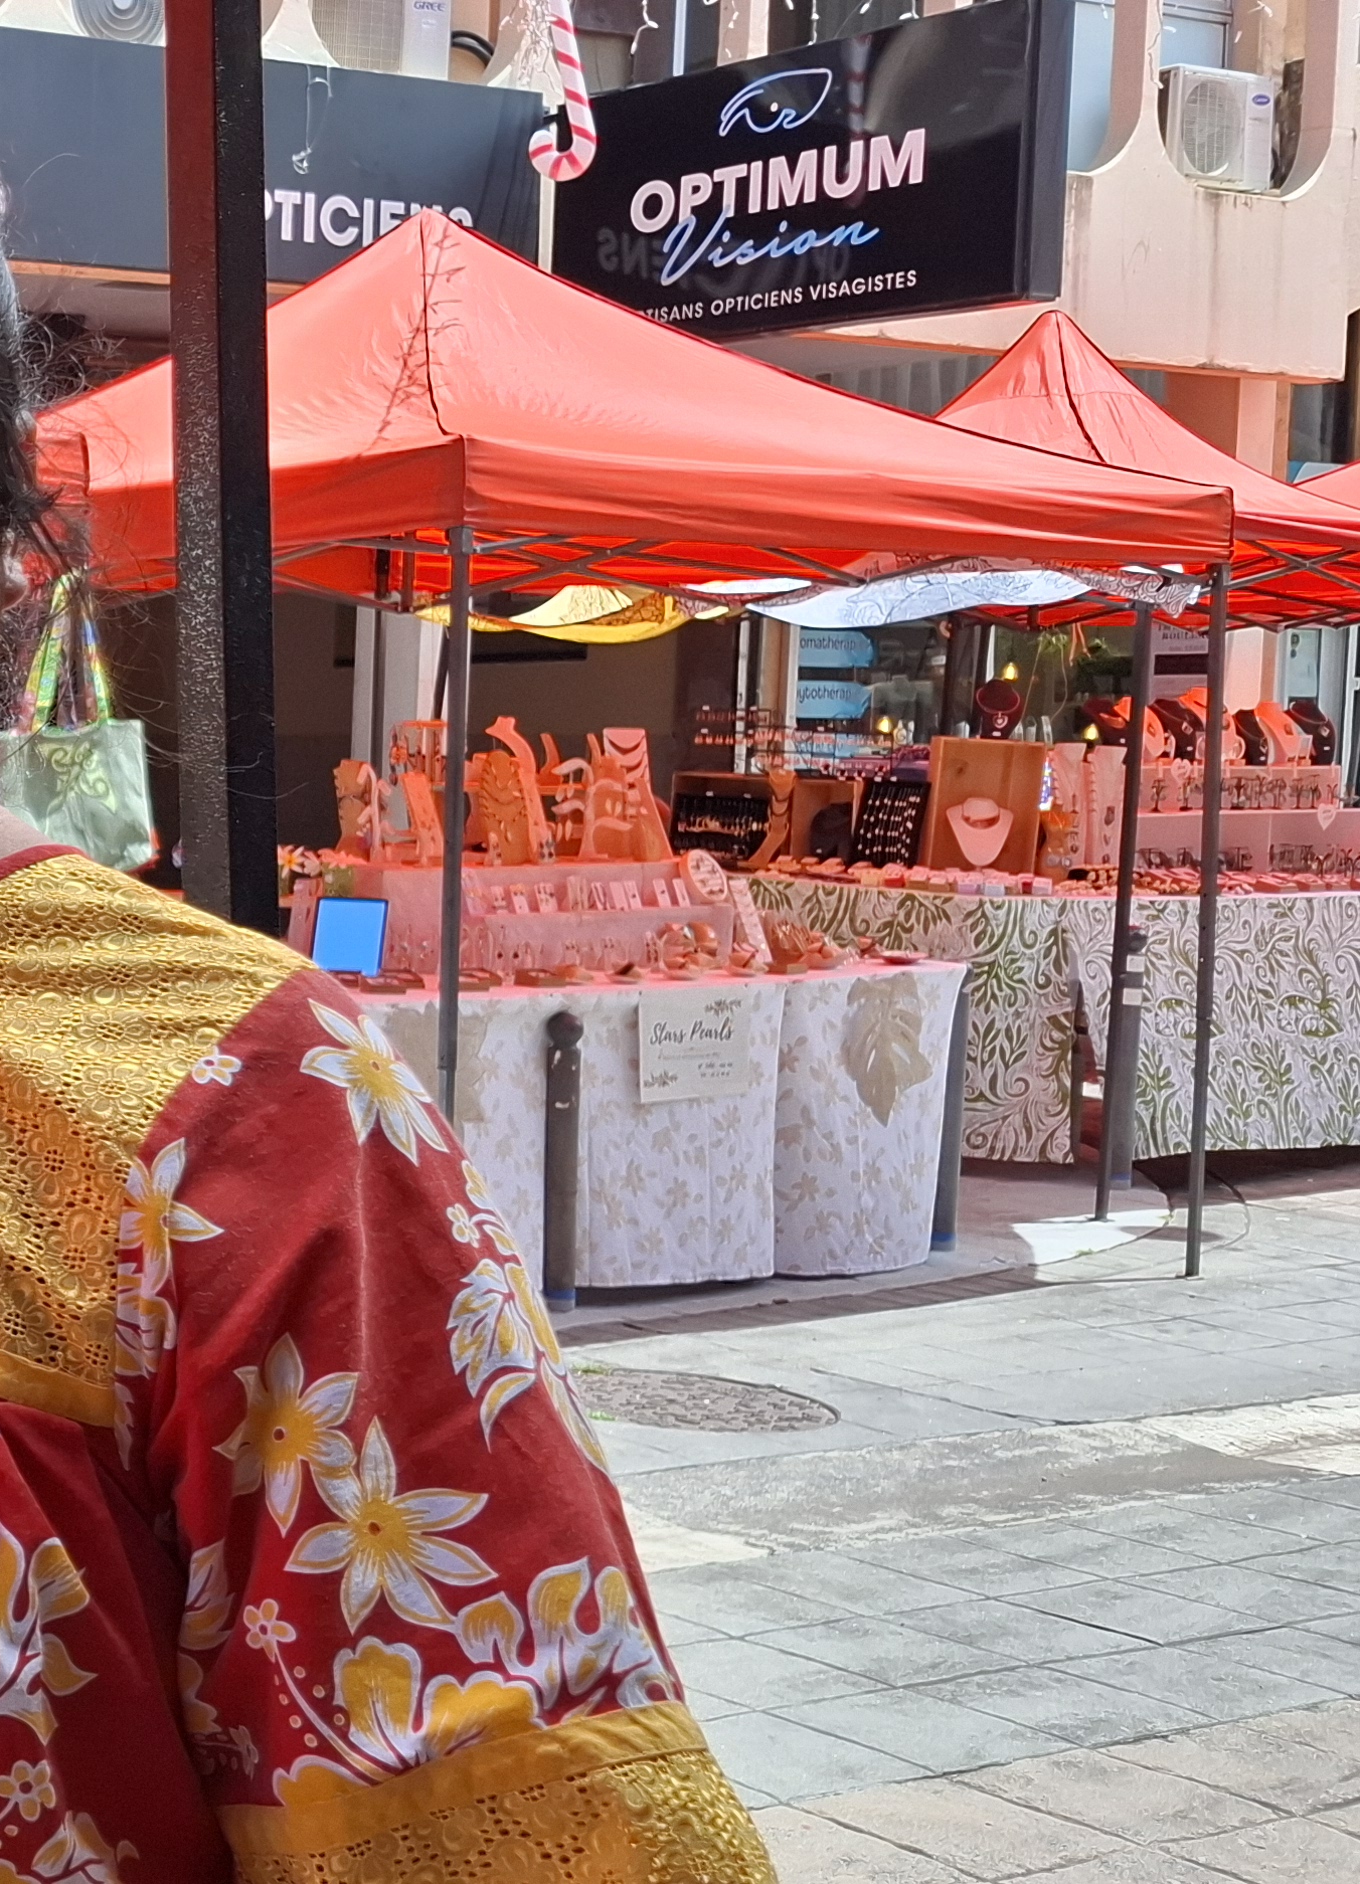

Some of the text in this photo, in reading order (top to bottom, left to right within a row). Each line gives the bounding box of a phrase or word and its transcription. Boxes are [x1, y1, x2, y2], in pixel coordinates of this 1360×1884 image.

[630, 128, 926, 233] OPTIMUM
[660, 204, 880, 287] Vision
[710, 286, 804, 317] OPTICIENS
[809, 269, 919, 300] VISAGISTES
[649, 1016, 734, 1046] Stars Pearls
